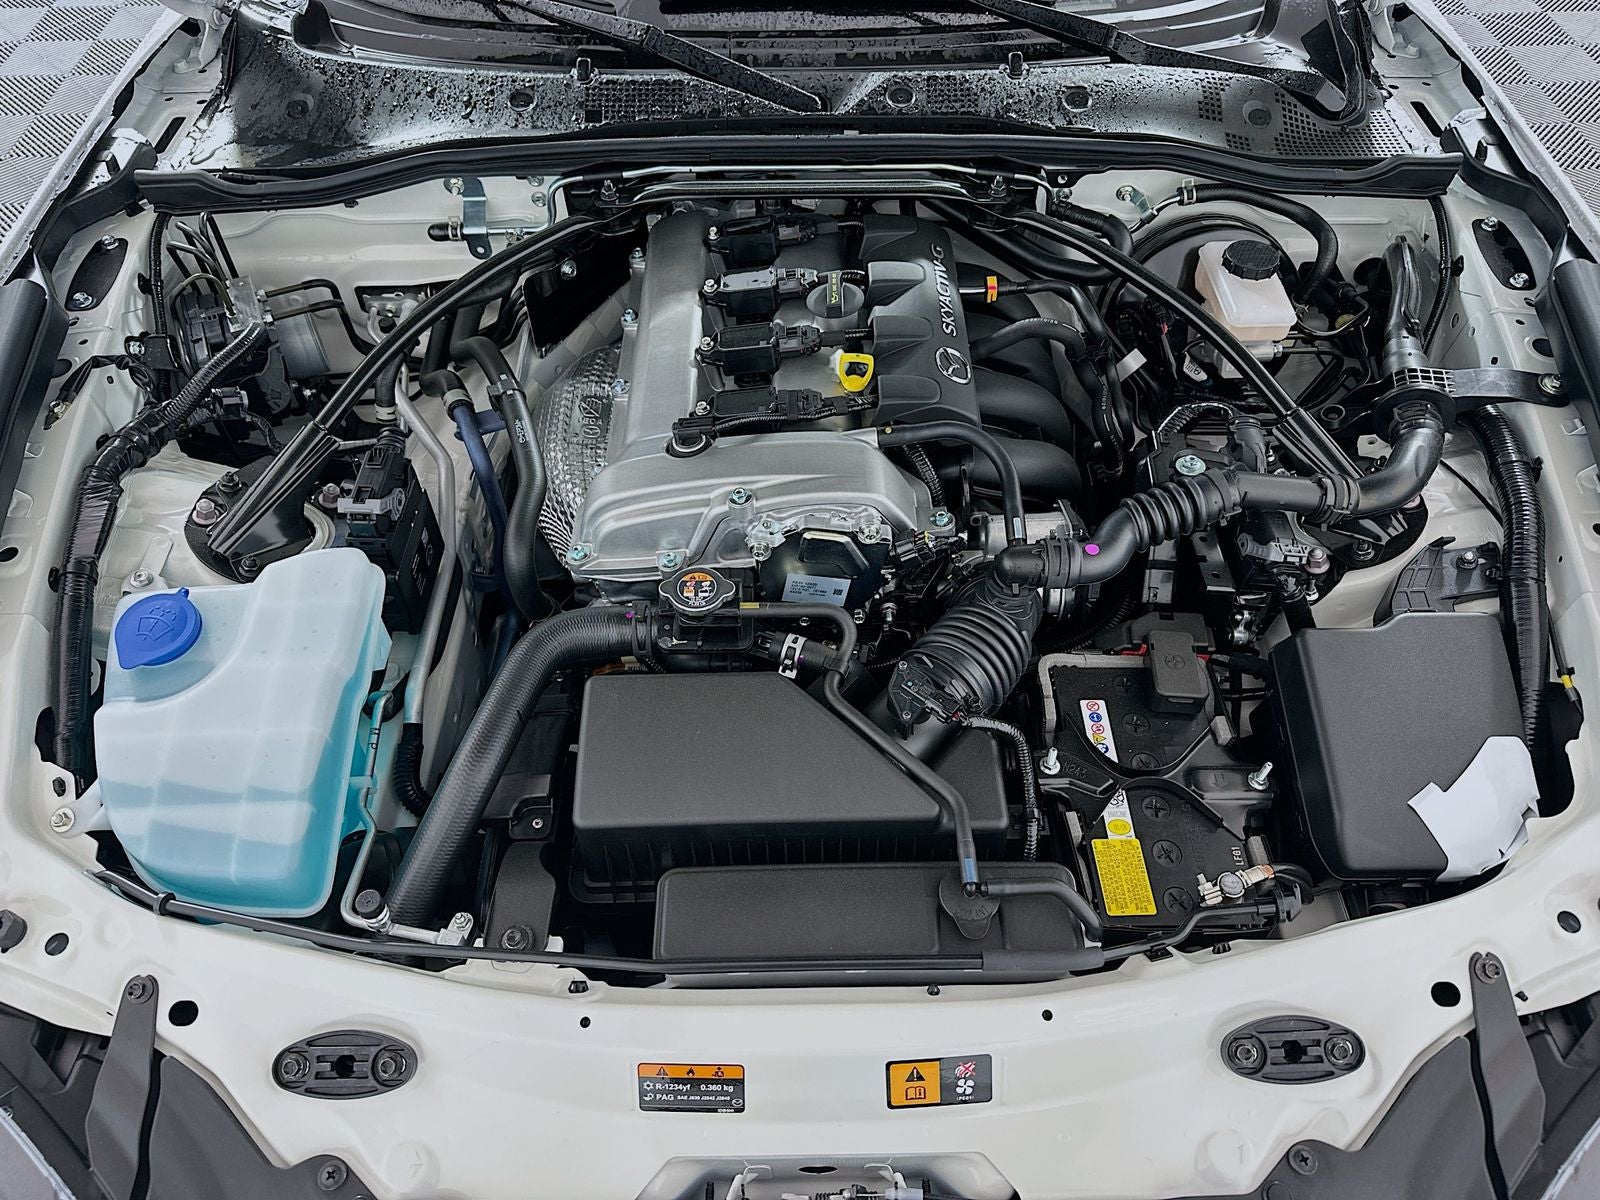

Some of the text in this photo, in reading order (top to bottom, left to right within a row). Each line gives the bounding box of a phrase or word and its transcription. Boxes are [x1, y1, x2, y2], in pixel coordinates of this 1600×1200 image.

[930, 243, 957, 337] SKYACTIV-G
[655, 1083, 691, 1092] R-1234yf
[723, 1084, 734, 1092] kg
